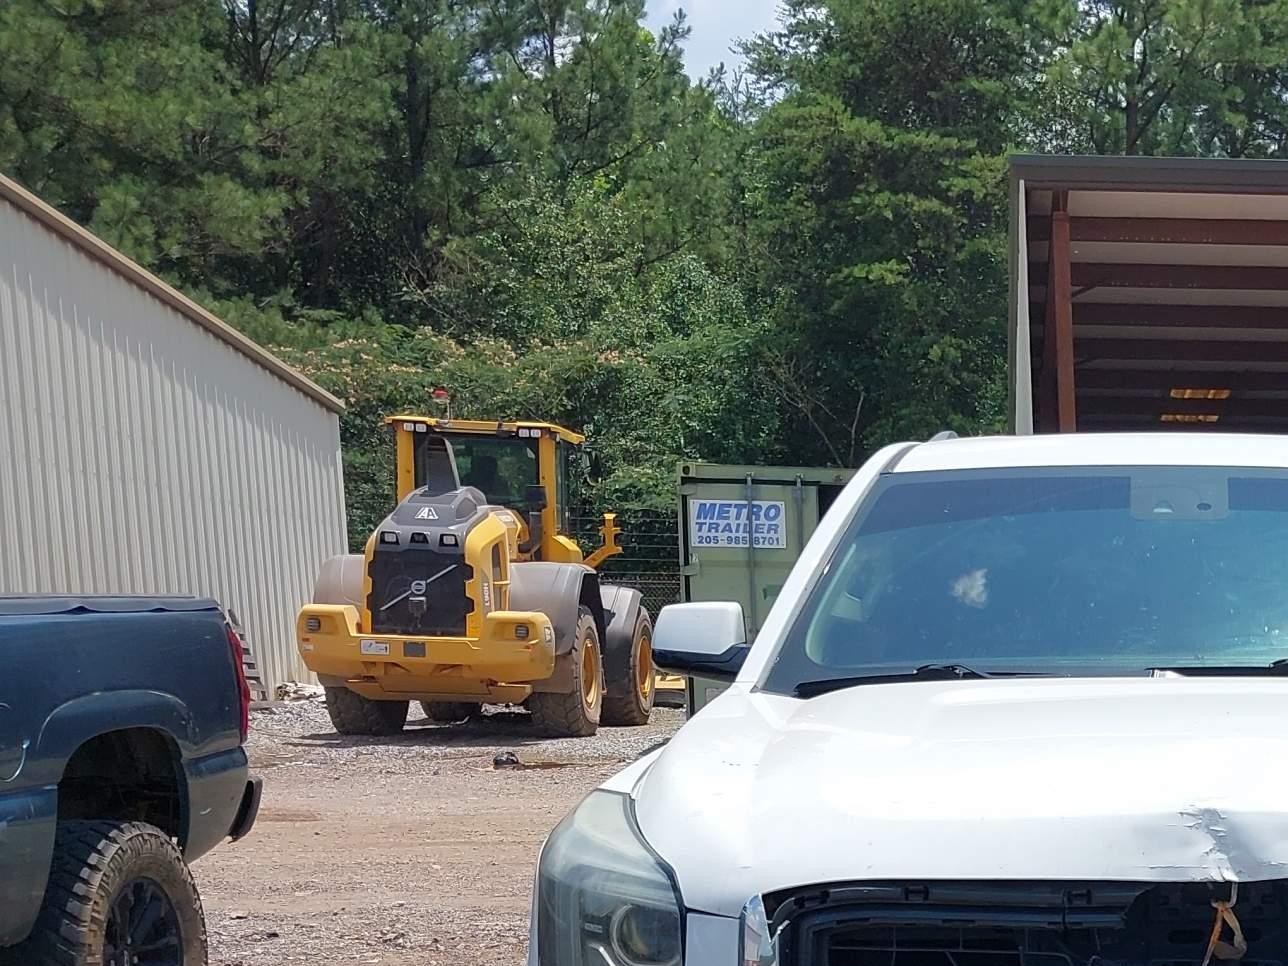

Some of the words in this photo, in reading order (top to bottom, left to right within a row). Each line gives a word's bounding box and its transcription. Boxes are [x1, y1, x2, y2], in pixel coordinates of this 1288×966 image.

[695, 503, 781, 521] METRO
[695, 522, 780, 534] TRAILER
[697, 536, 780, 546] 205-9858701
